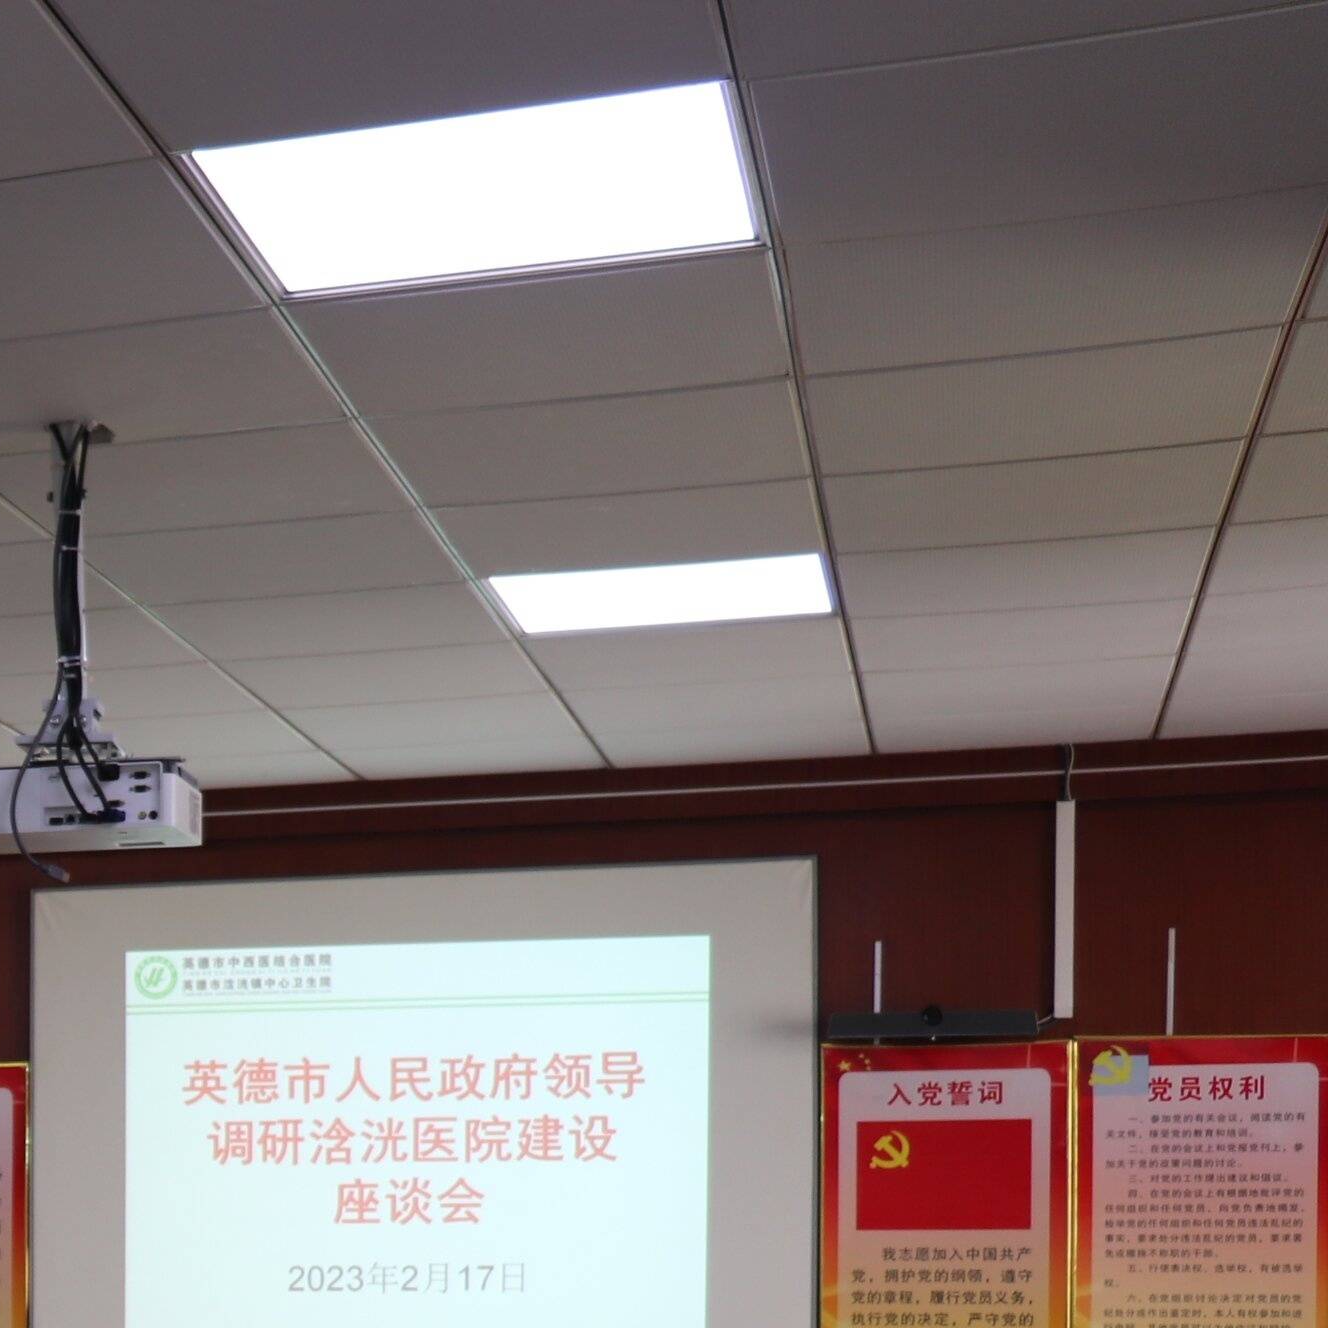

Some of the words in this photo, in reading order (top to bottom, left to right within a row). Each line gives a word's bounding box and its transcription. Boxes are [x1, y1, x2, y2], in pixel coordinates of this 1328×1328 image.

[182, 1050, 646, 1106] 英德市人民政府领导
[887, 1080, 1004, 1107] 入党誓词
[1147, 1075, 1266, 1102] 党员权利
[206, 1113, 619, 1167] 调研浛洸医院建设
[332, 1176, 486, 1226] 座谈会
[881, 1247, 1033, 1262] 我志愿加入中国共产
[287, 1260, 528, 1295] 2023年2月17日
